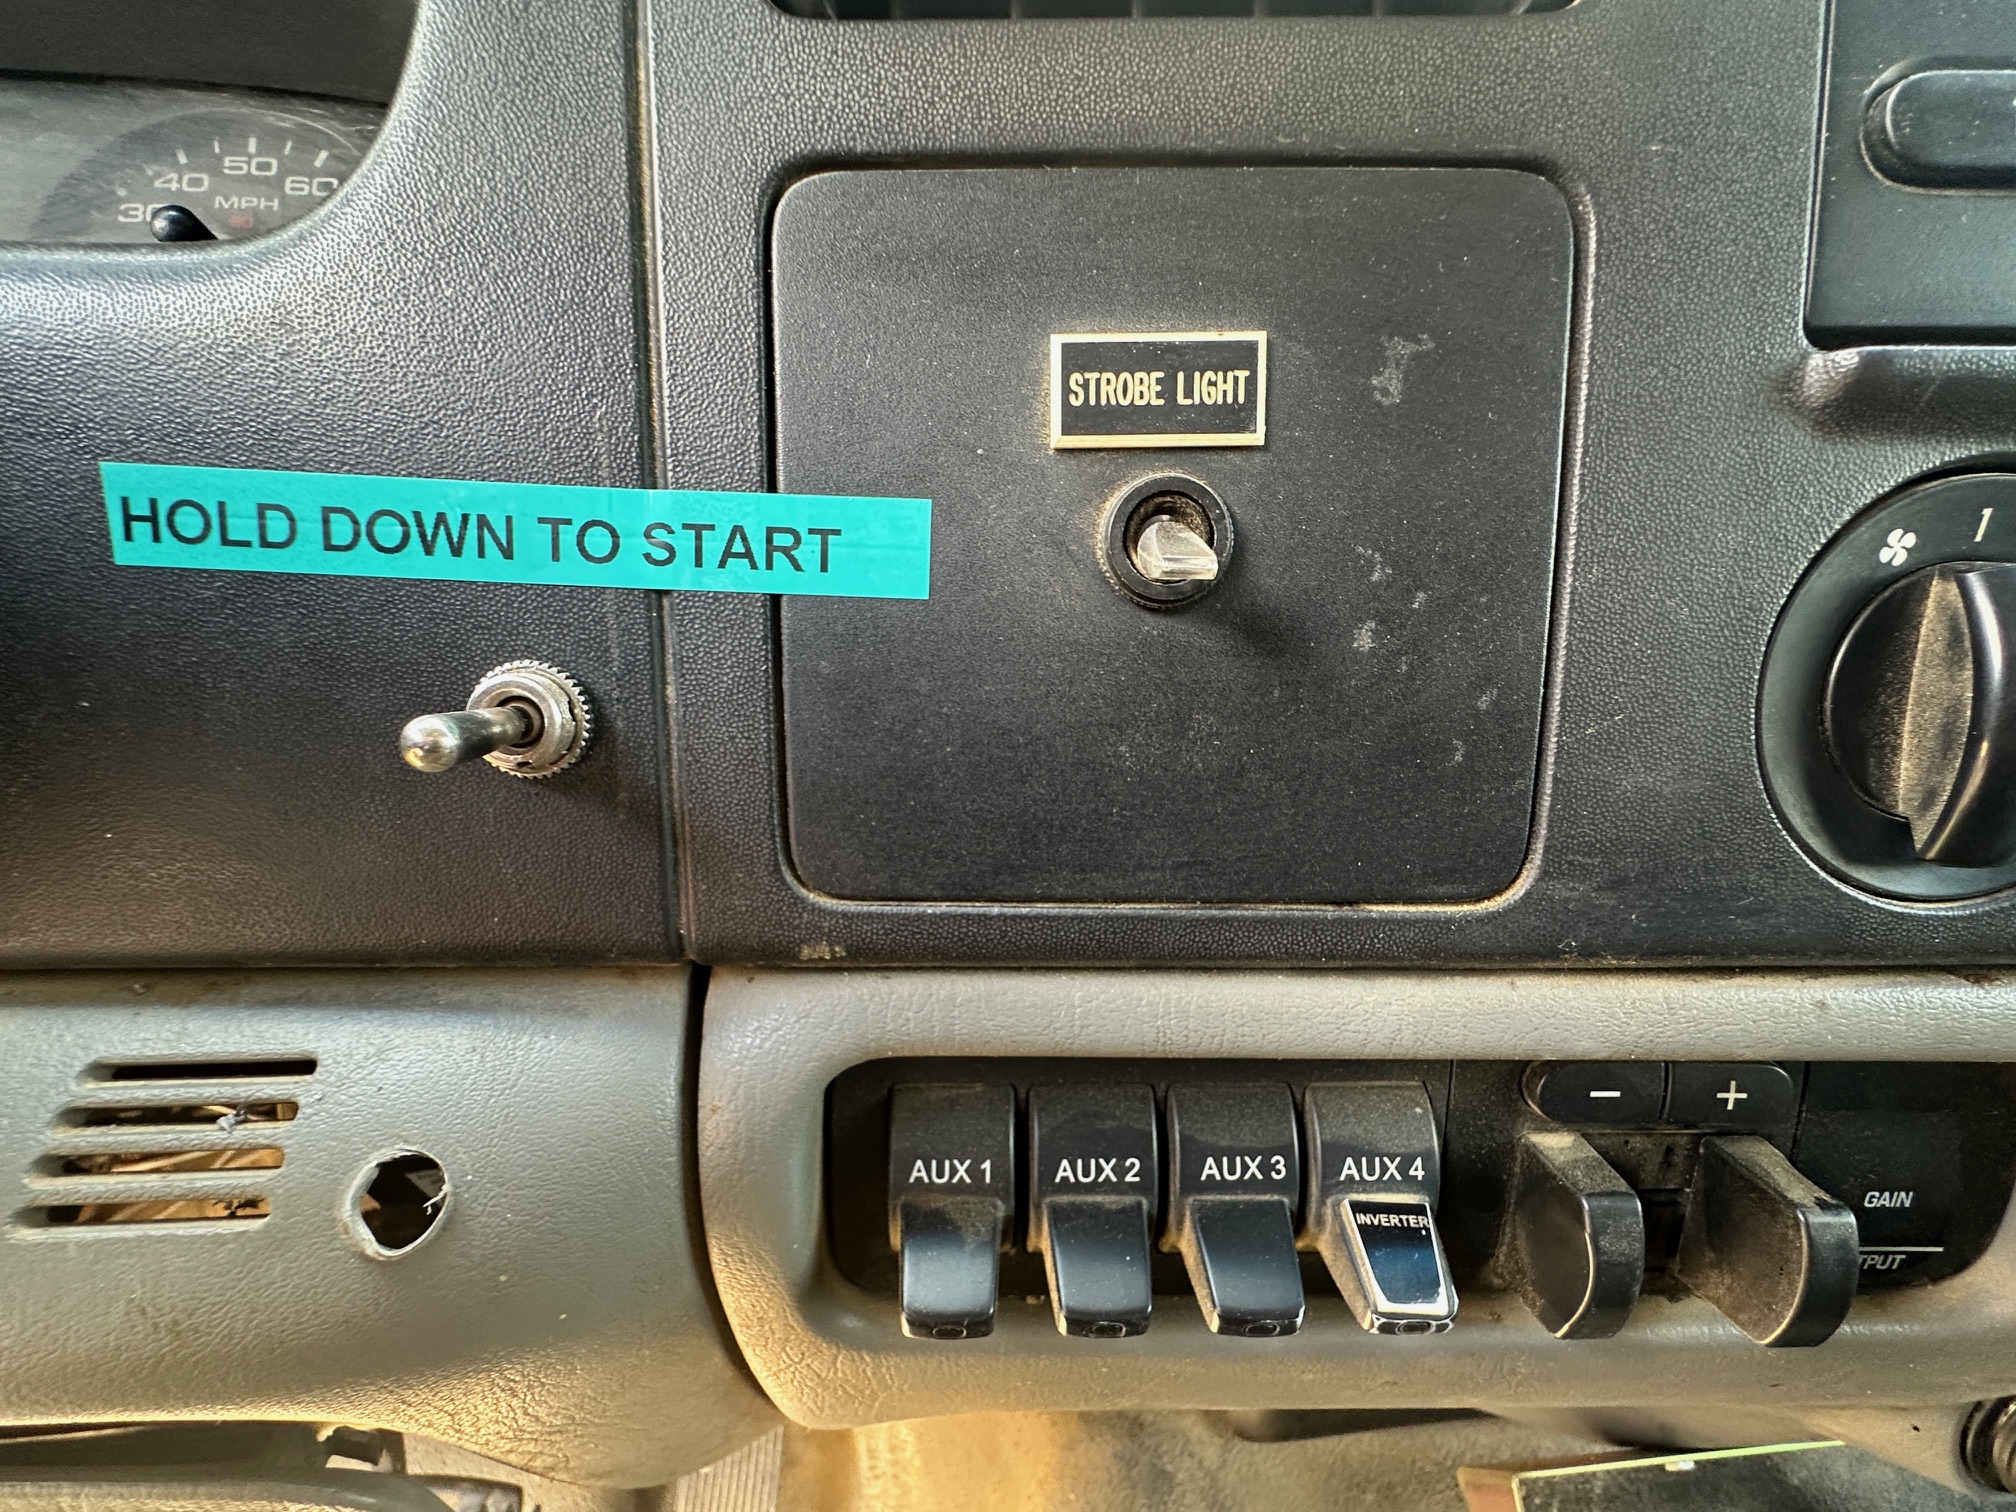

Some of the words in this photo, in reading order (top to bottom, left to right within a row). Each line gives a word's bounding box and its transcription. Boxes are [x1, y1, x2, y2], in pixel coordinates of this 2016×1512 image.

[223, 156, 278, 176] 50
[154, 173, 210, 192] 40
[285, 176, 339, 196] 60
[214, 195, 279, 211] MPH
[1068, 371, 1165, 406] STROBE
[1177, 369, 1250, 405] LIGHT
[121, 497, 298, 550] HOLD
[321, 506, 515, 560] DOWN
[537, 517, 620, 564] TO
[641, 521, 842, 574] START
[1973, 507, 1994, 542] 1
[909, 1159, 972, 1184] AUX
[980, 1160, 993, 1184] 1
[1054, 1158, 1118, 1183] AUX
[1124, 1157, 1141, 1183] 2
[1200, 1156, 1266, 1182] AUX
[1270, 1155, 1287, 1180] 3
[1339, 1157, 1406, 1182] AUX
[1408, 1156, 1426, 1181] 4
[1863, 1190, 1914, 1208] GAIN
[1355, 1212, 1431, 1229] INVERTER
[1859, 1254, 1907, 1270] TPUT
